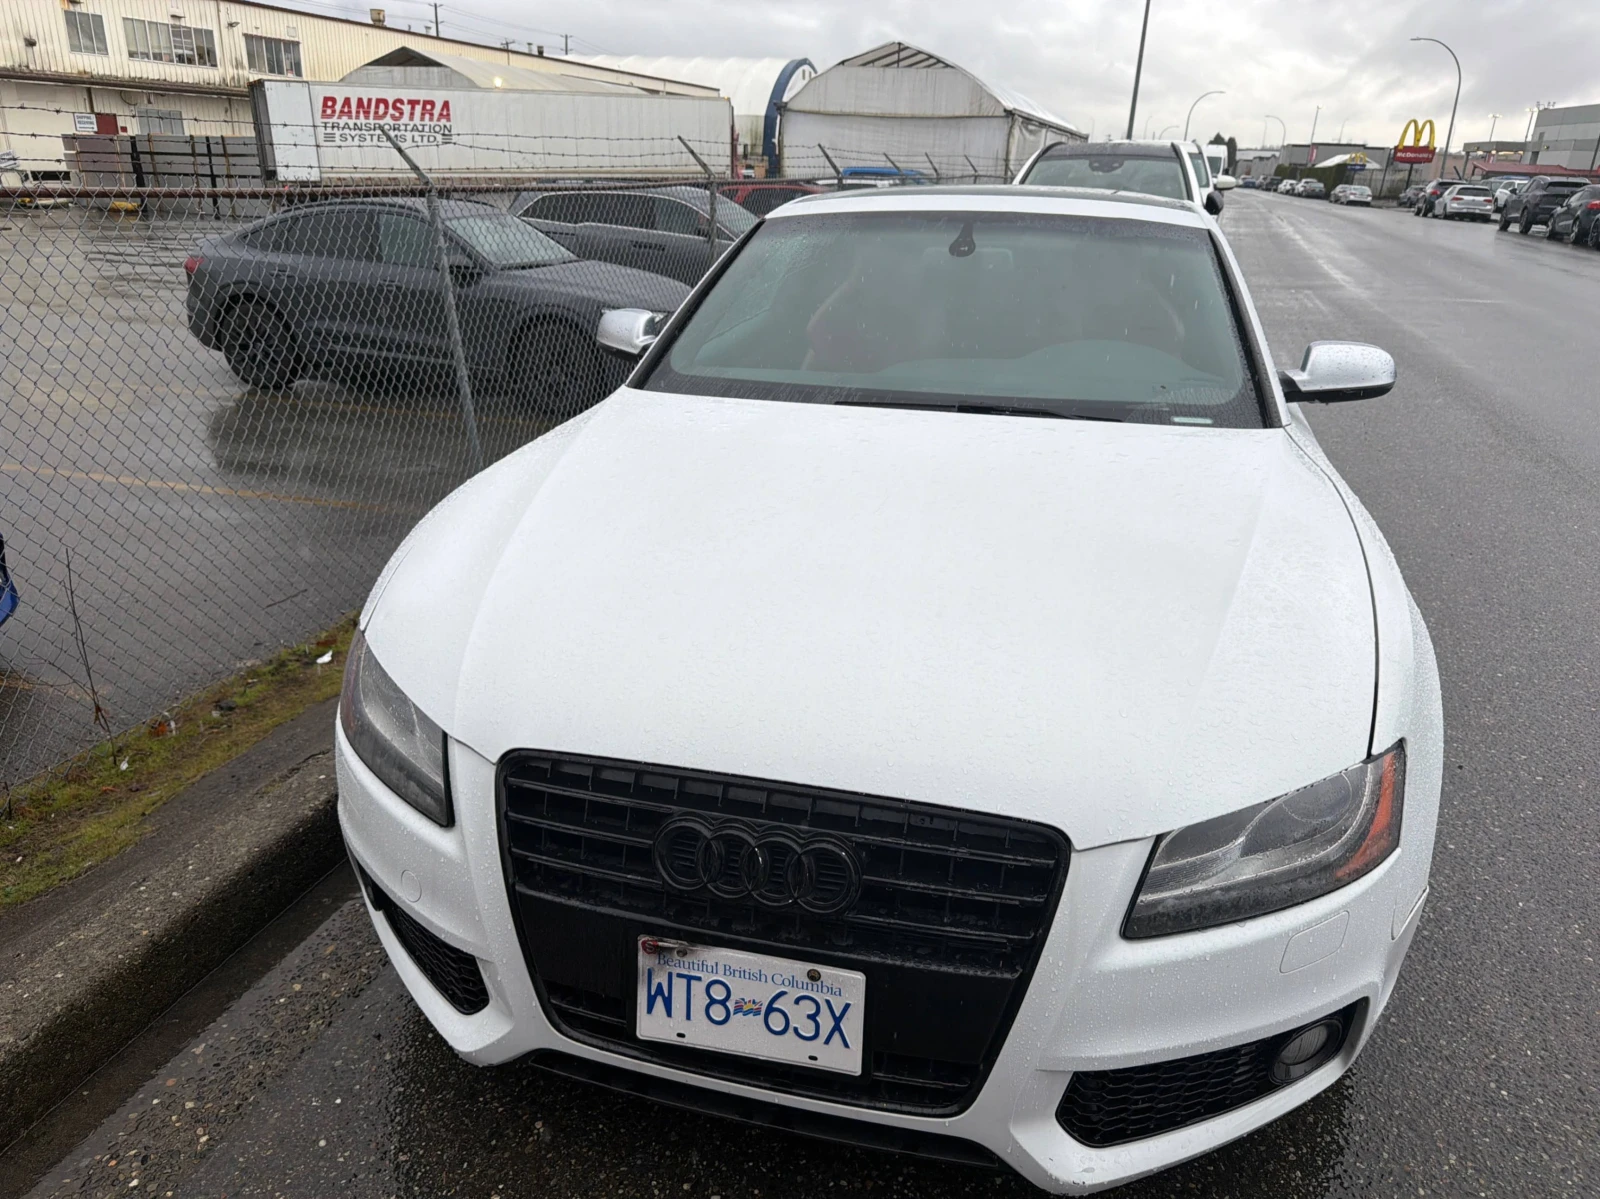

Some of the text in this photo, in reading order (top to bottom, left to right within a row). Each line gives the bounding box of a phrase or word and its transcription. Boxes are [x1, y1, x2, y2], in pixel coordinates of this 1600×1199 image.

[320, 96, 452, 122] BANDSTRA
[321, 121, 452, 133] TRANSPORTATION
[411, 134, 439, 143] LTD.
[657, 952, 842, 997] Beautiful British Columbia
[646, 967, 852, 1050] WT8 63X
